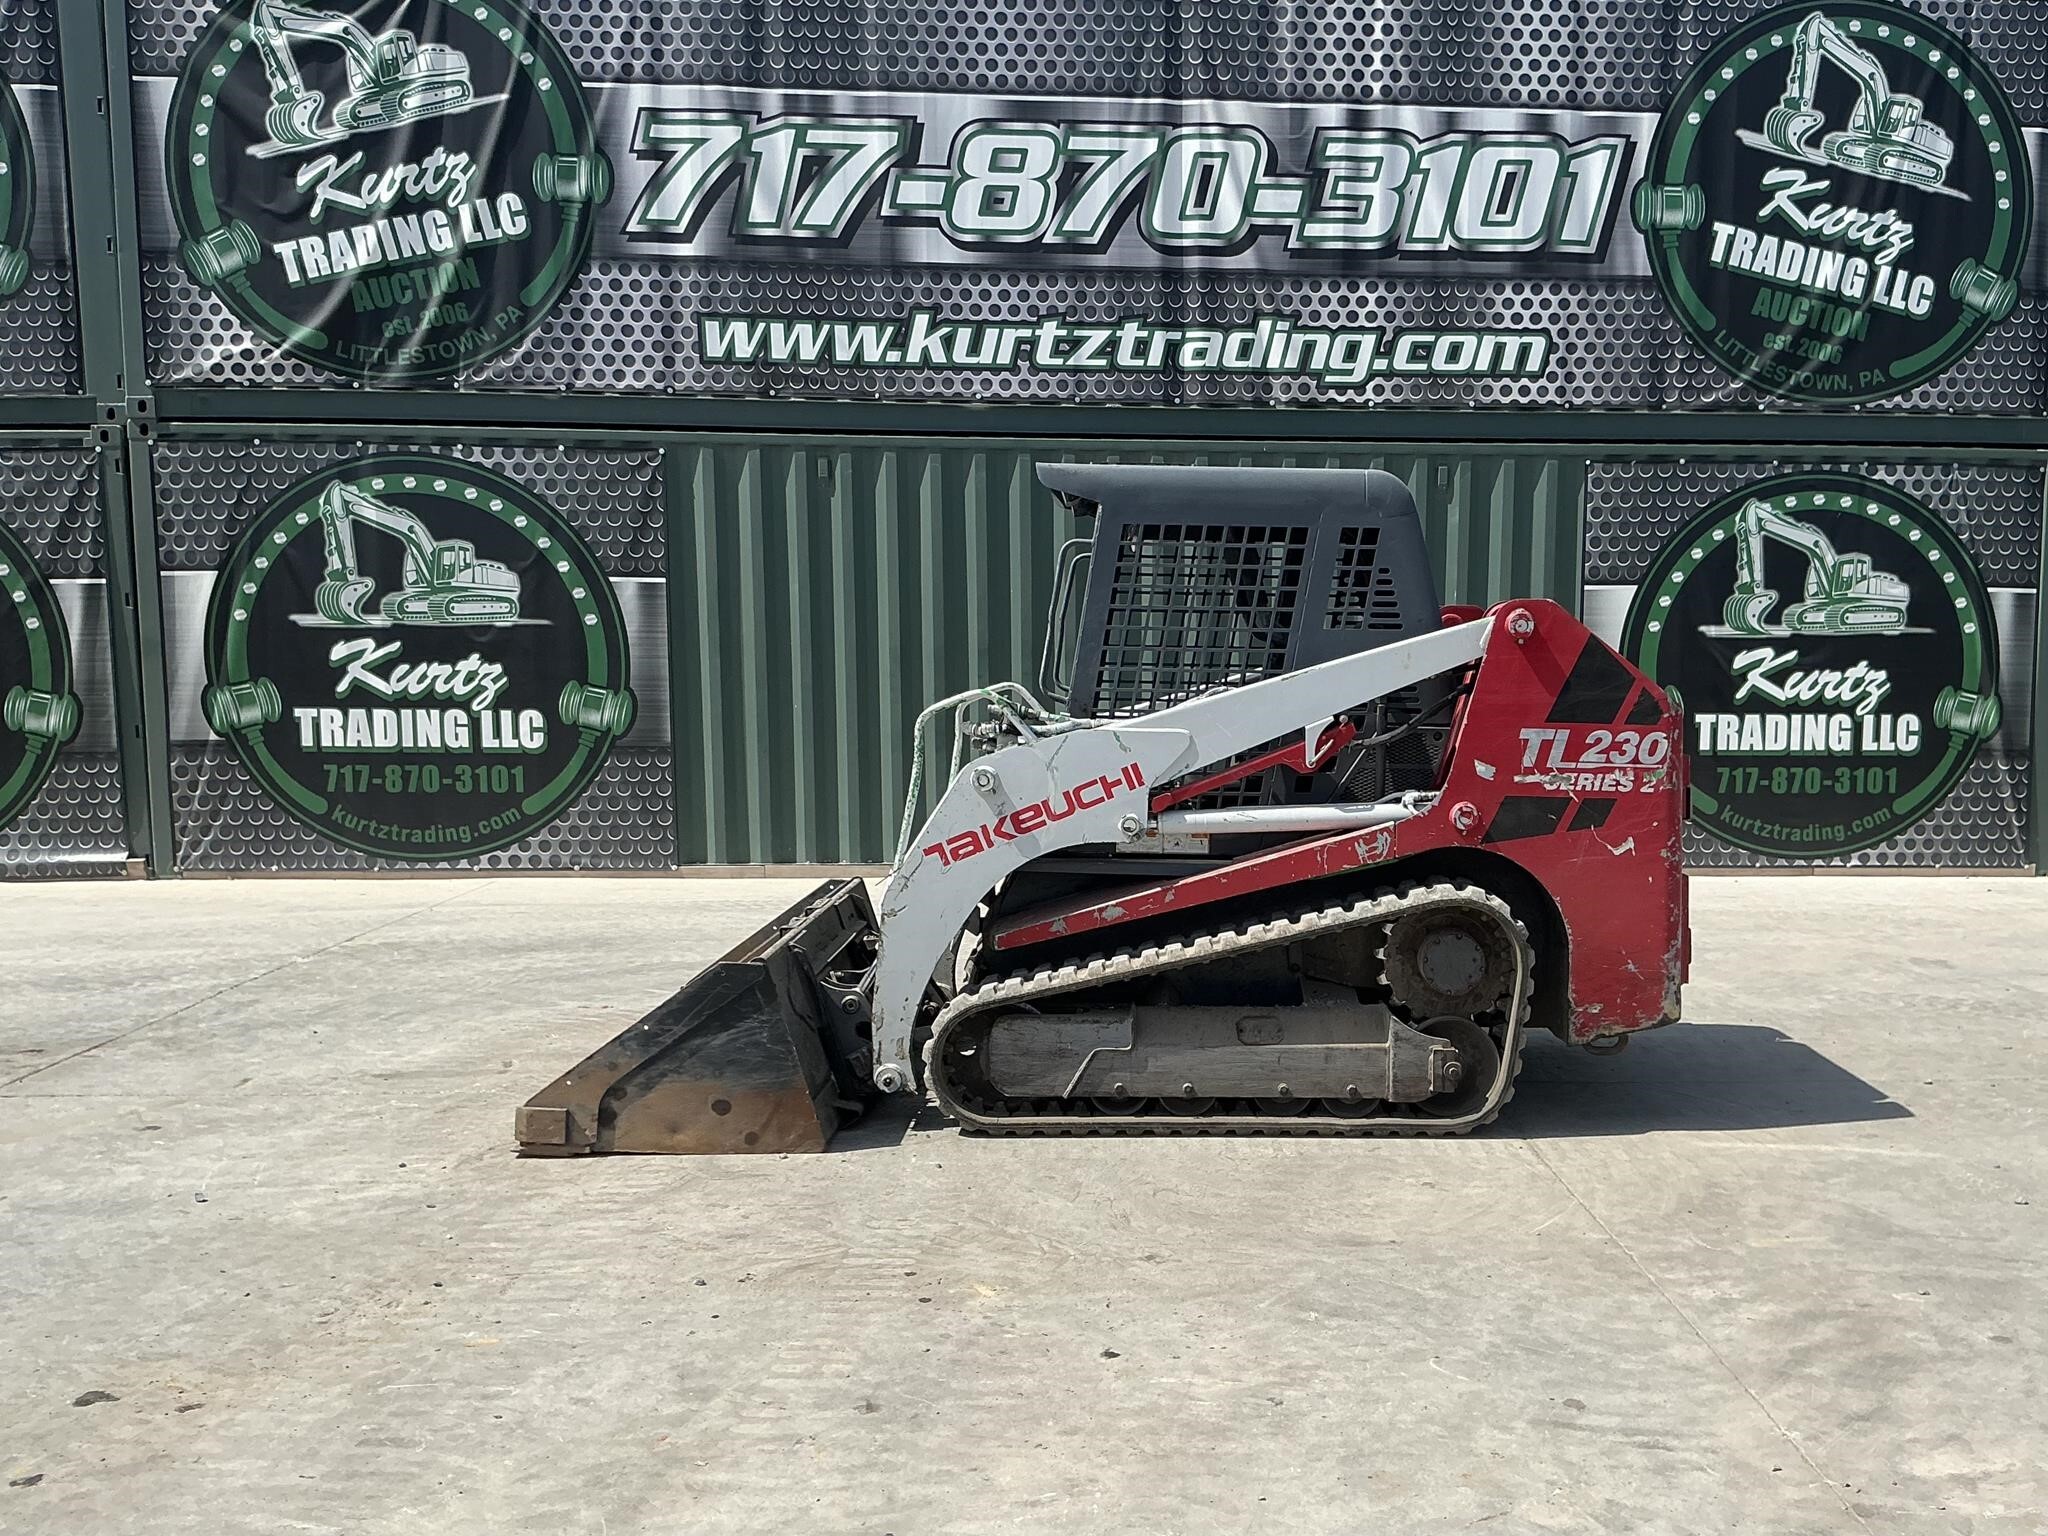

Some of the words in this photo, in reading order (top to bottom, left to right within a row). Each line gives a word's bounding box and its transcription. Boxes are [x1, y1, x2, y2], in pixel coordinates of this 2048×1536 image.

[296, 147, 477, 219] Kurtz
[628, 110, 1629, 265] 717-870-3101
[274, 209, 455, 285] TRADING
[459, 191, 531, 246] LLC
[1757, 167, 1914, 263] Kurtz
[353, 257, 481, 313] AUCTION
[1710, 222, 1868, 299] TRADING
[1872, 263, 1936, 317] LLC
[334, 325, 498, 366] LITTLESTOWN,
[494, 304, 525, 331] PA
[1751, 287, 1871, 342] AUCTION
[701, 313, 1550, 388] www.kurtztrading.com
[1713, 329, 1853, 391] LITTLESTOWN,
[1859, 368, 1886, 388] PA
[329, 637, 509, 711] Kurtz
[1731, 646, 1892, 716] Kurtz
[294, 707, 472, 753] TRADING
[480, 708, 548, 752] LLC
[1695, 713, 1853, 755] TRADING
[1861, 713, 1922, 754] LLC
[323, 763, 526, 795] 717-870-3101
[1543, 771, 1634, 793] SERIES
[1639, 778, 1657, 793] 2
[1715, 765, 1899, 797] 717-870-3101
[331, 803, 522, 845] kurtztrading.com
[1719, 803, 1893, 844] kurtztrading.com
